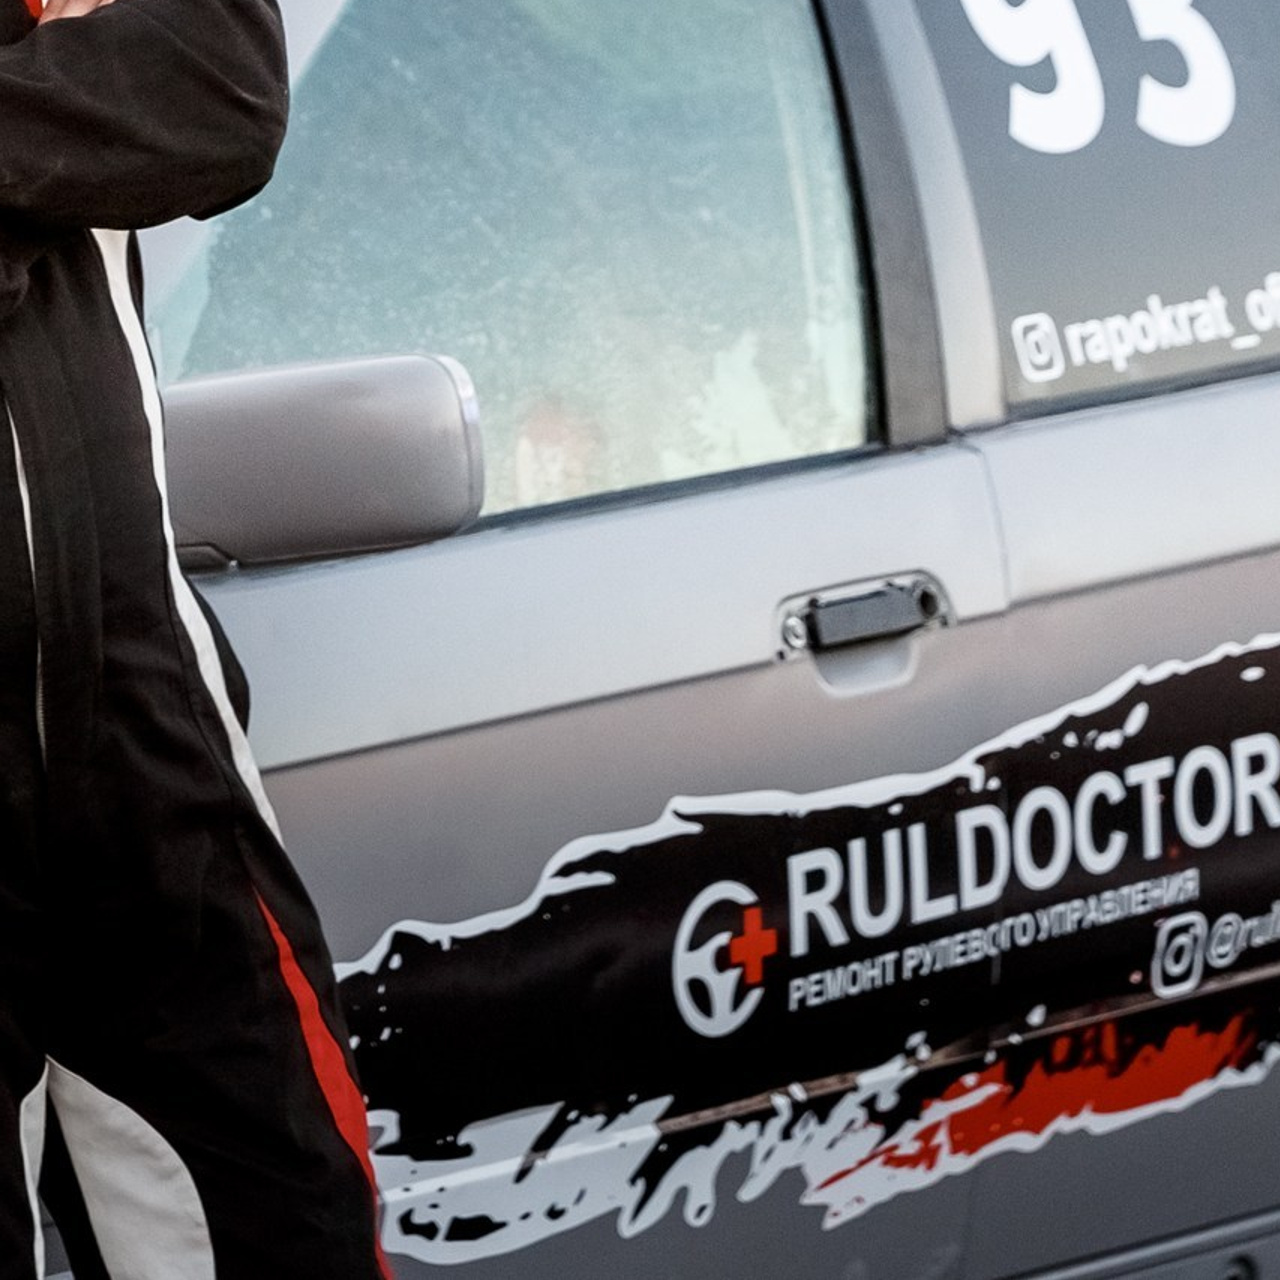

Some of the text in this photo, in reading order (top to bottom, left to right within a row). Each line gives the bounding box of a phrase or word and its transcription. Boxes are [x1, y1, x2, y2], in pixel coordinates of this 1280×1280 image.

[787, 732, 1280, 957] RULDOCTOR
[788, 951, 900, 1012] РЕМОНТ
[902, 911, 1038, 981] РУЛЕВОГО
